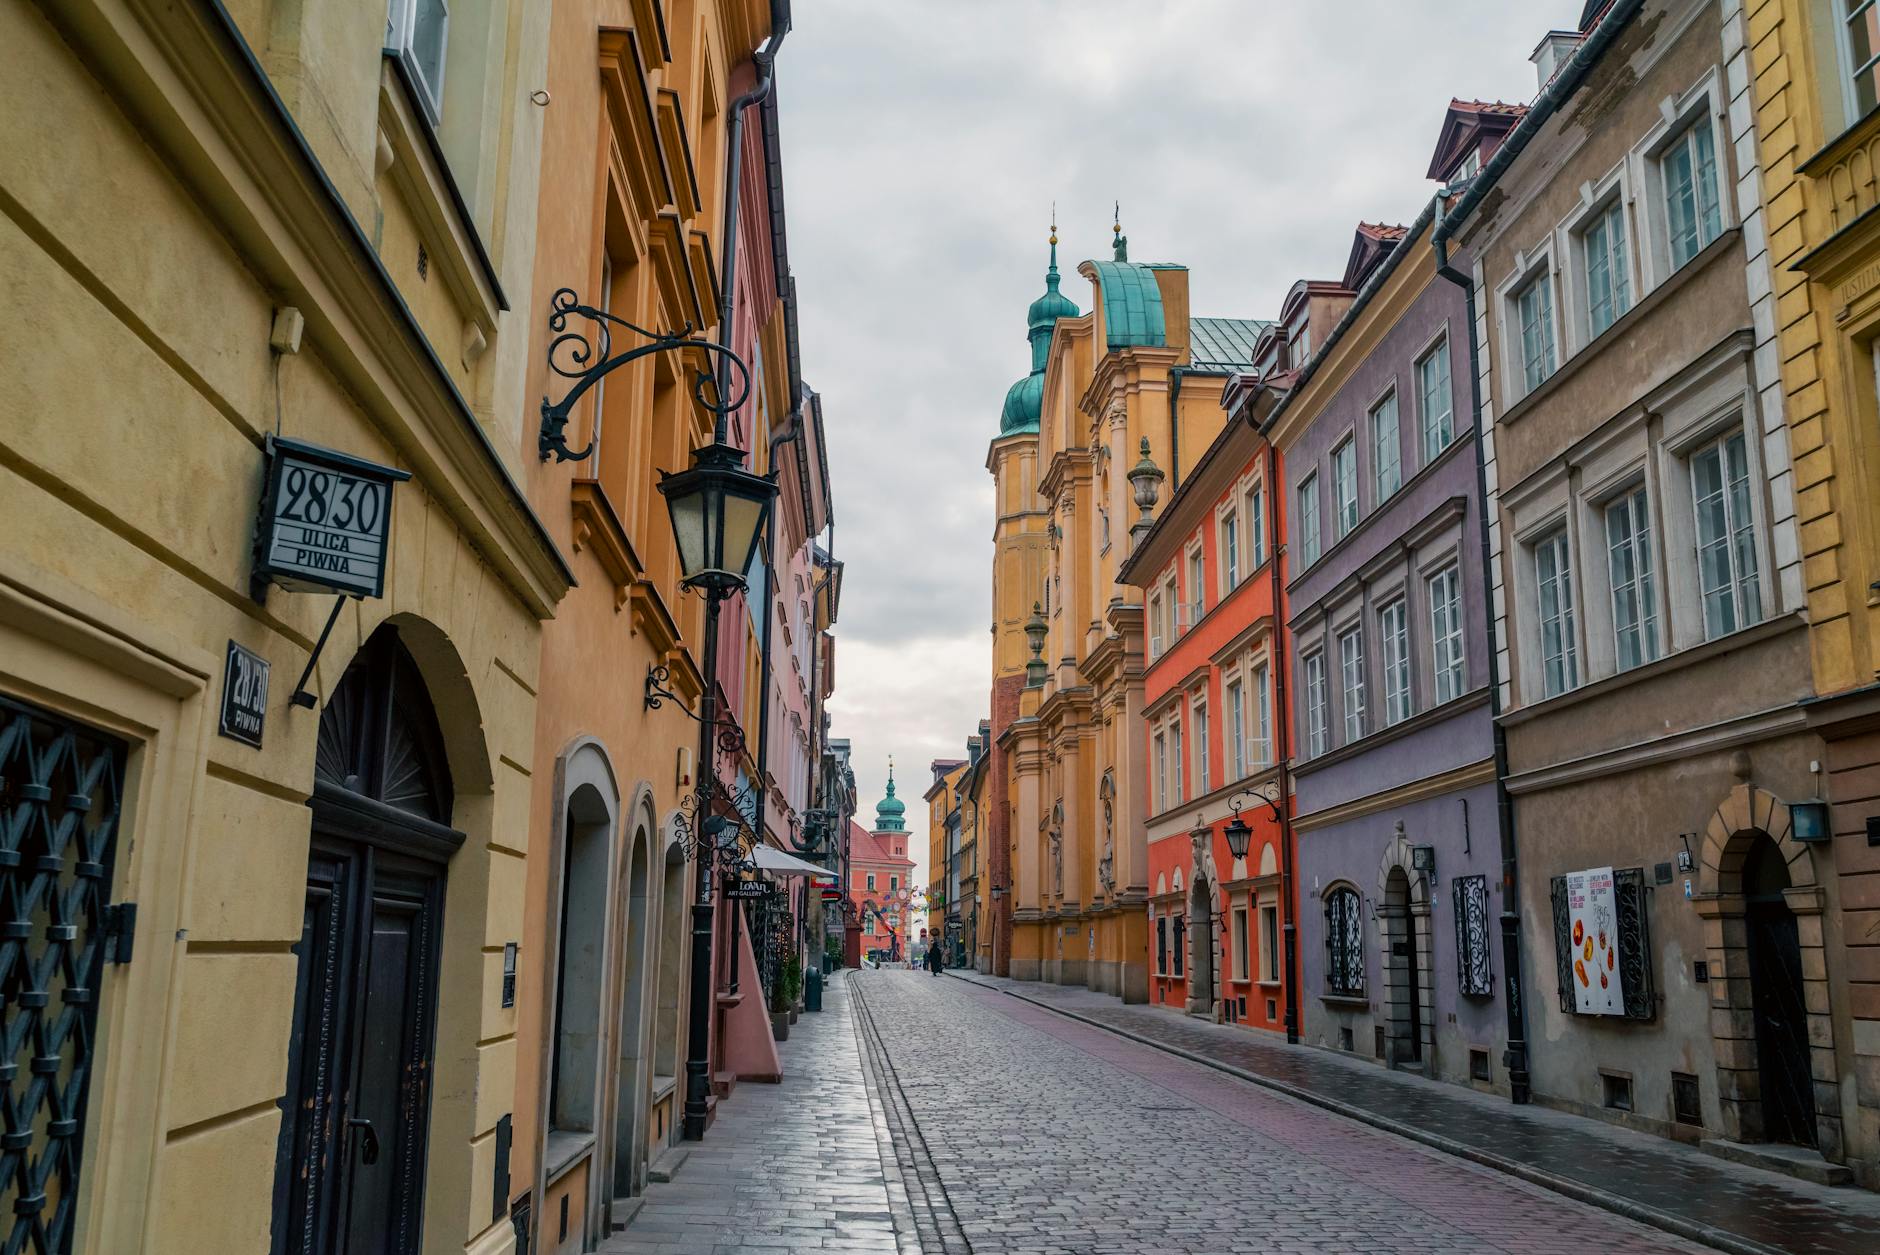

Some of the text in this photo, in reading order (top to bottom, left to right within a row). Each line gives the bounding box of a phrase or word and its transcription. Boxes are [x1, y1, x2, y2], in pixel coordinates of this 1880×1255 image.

[302, 528, 350, 553] ULICA
[295, 549, 350, 574] PIWNA
[233, 652, 269, 715] 28/30
[234, 709, 261, 735] PIWNA
